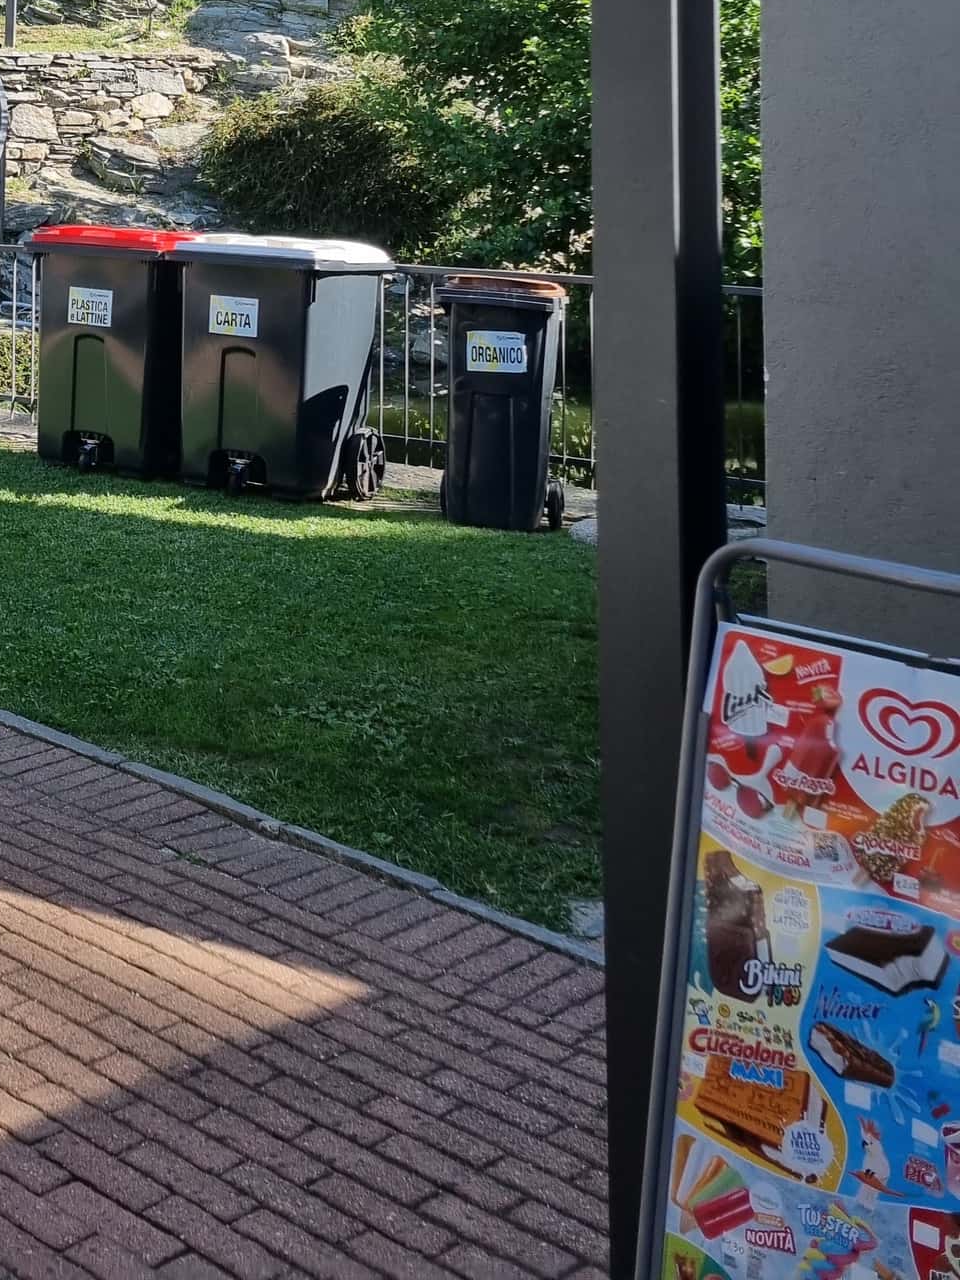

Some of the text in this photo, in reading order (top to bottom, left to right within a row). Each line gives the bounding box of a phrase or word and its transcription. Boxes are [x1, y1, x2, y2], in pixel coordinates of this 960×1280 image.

[71, 298, 108, 312] PLASTICA
[70, 311, 109, 325] e LATTINE
[216, 311, 251, 328] CARTA
[471, 345, 523, 364] ORGANICO
[851, 753, 959, 800] ALGIDA
[739, 959, 802, 995] Bikini
[766, 986, 802, 1007] 1969
[689, 1027, 796, 1068] Cucciolone
[791, 1130, 818, 1144] LATTE
[791, 1140, 821, 1152] FRESCO
[746, 1226, 795, 1252] NOVITÀ
